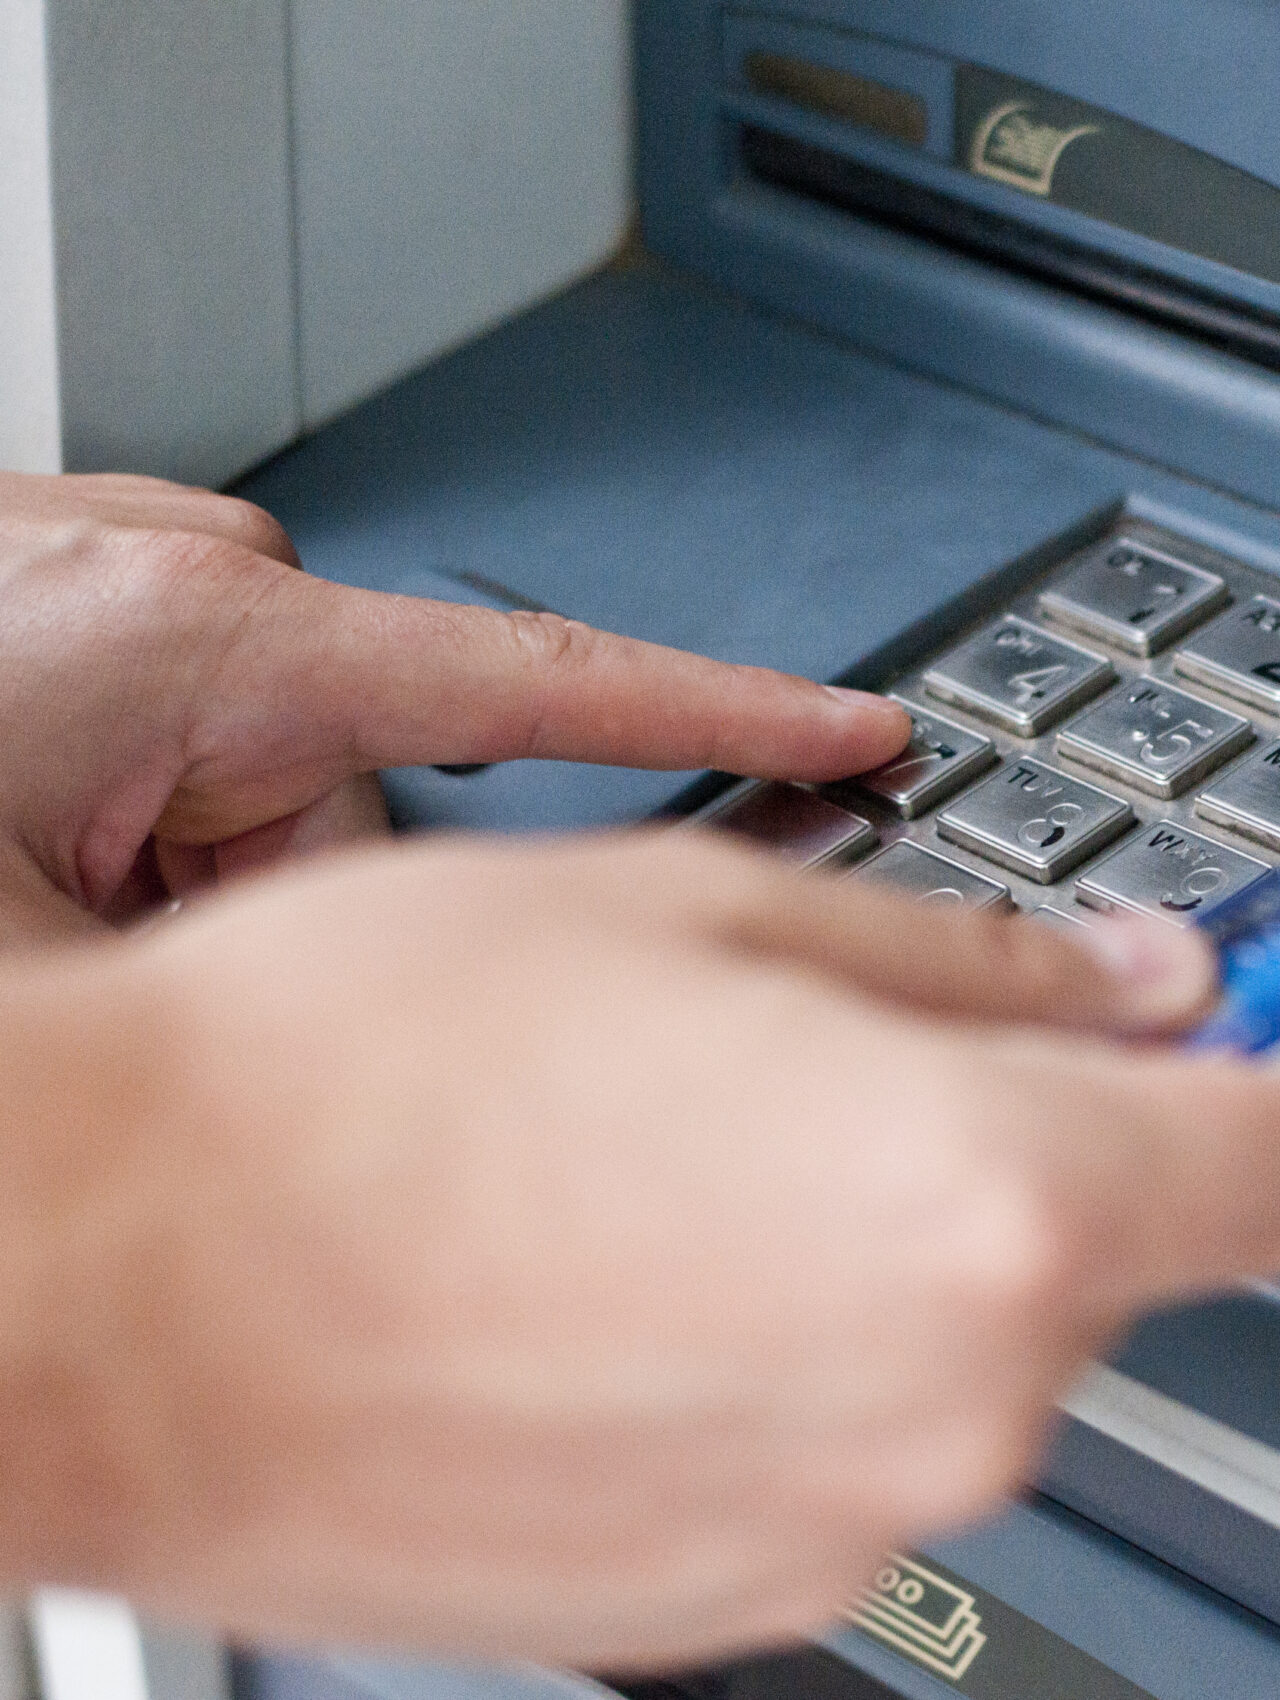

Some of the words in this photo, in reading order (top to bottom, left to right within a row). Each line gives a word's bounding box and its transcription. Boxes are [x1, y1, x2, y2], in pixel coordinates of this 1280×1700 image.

[1008, 664, 1068, 705] 4
[1140, 719, 1213, 764] 5
[1017, 802, 1085, 848] 8
[1160, 867, 1229, 912] 9
